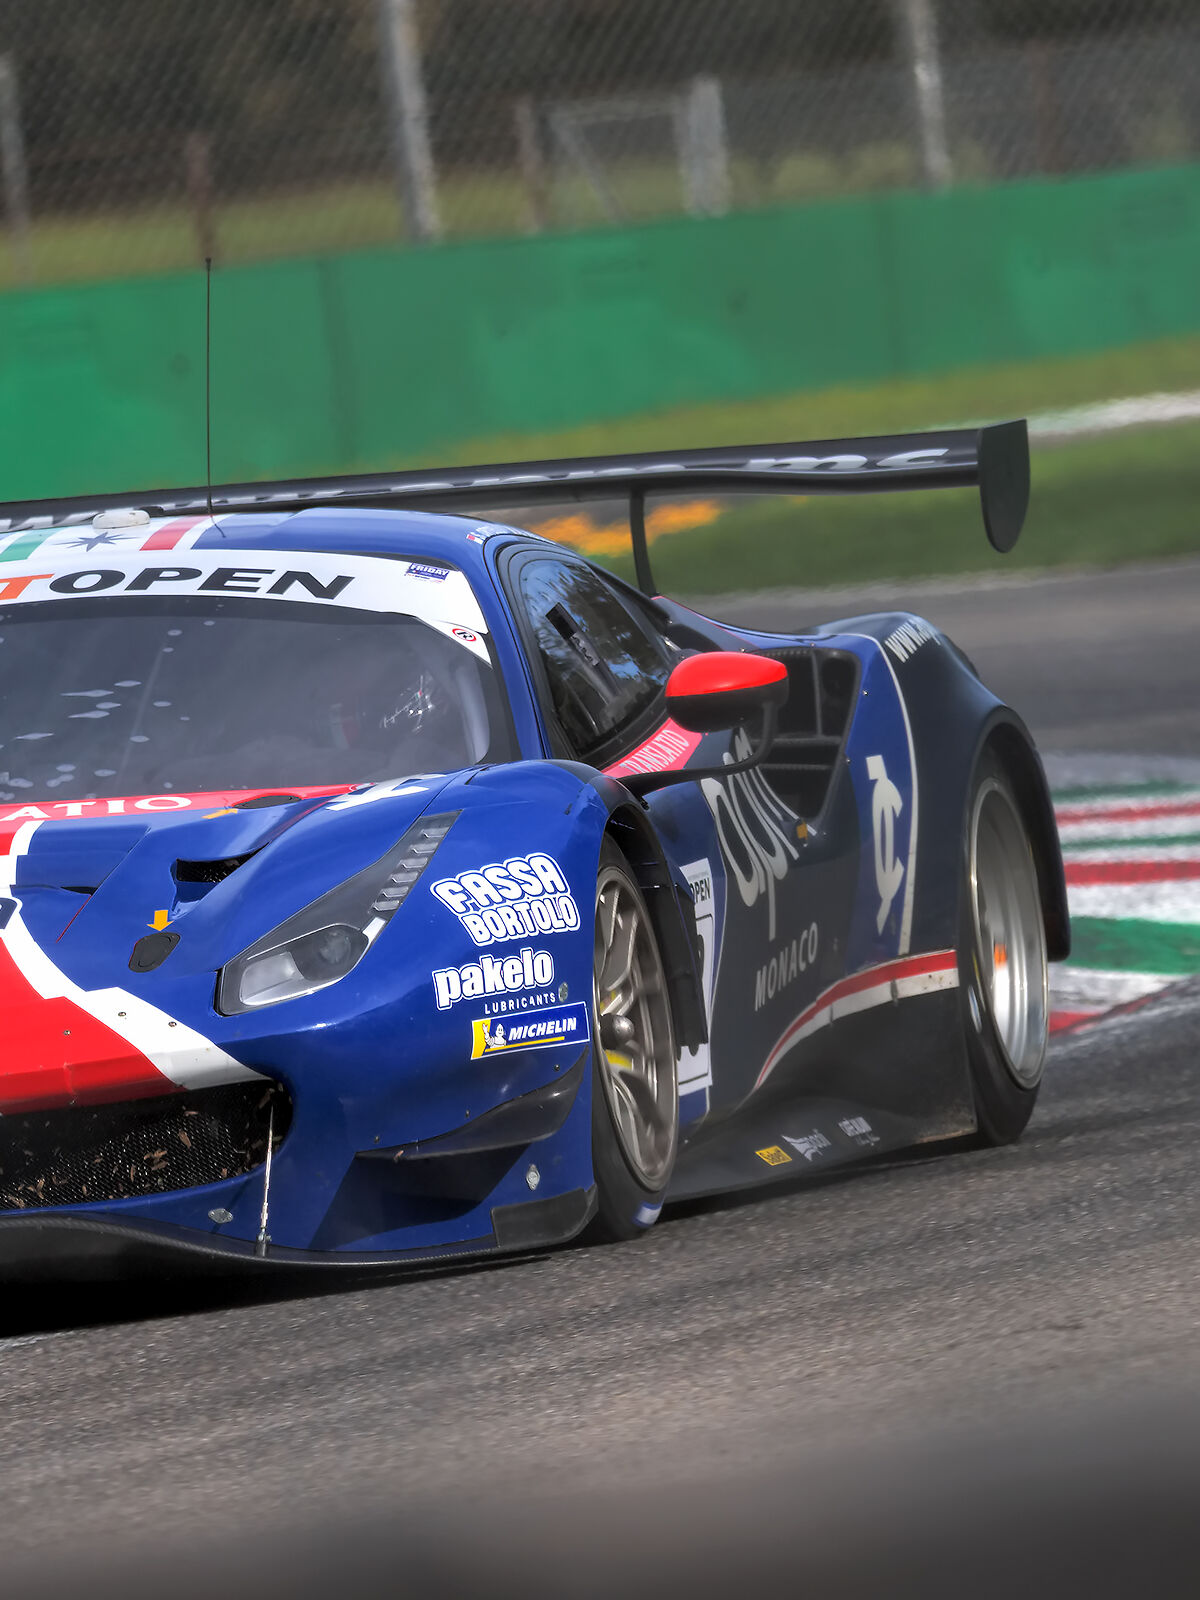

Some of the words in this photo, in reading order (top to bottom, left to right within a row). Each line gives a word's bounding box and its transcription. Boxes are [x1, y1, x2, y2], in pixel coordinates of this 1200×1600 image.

[431, 852, 570, 914] FASSA
[461, 894, 581, 946] BORTOLO
[432, 947, 555, 1011] pakelo
[755, 921, 819, 1012] MONACO
[484, 992, 557, 1015] LUBRICANTS
[507, 1016, 577, 1041] MICHELIN
